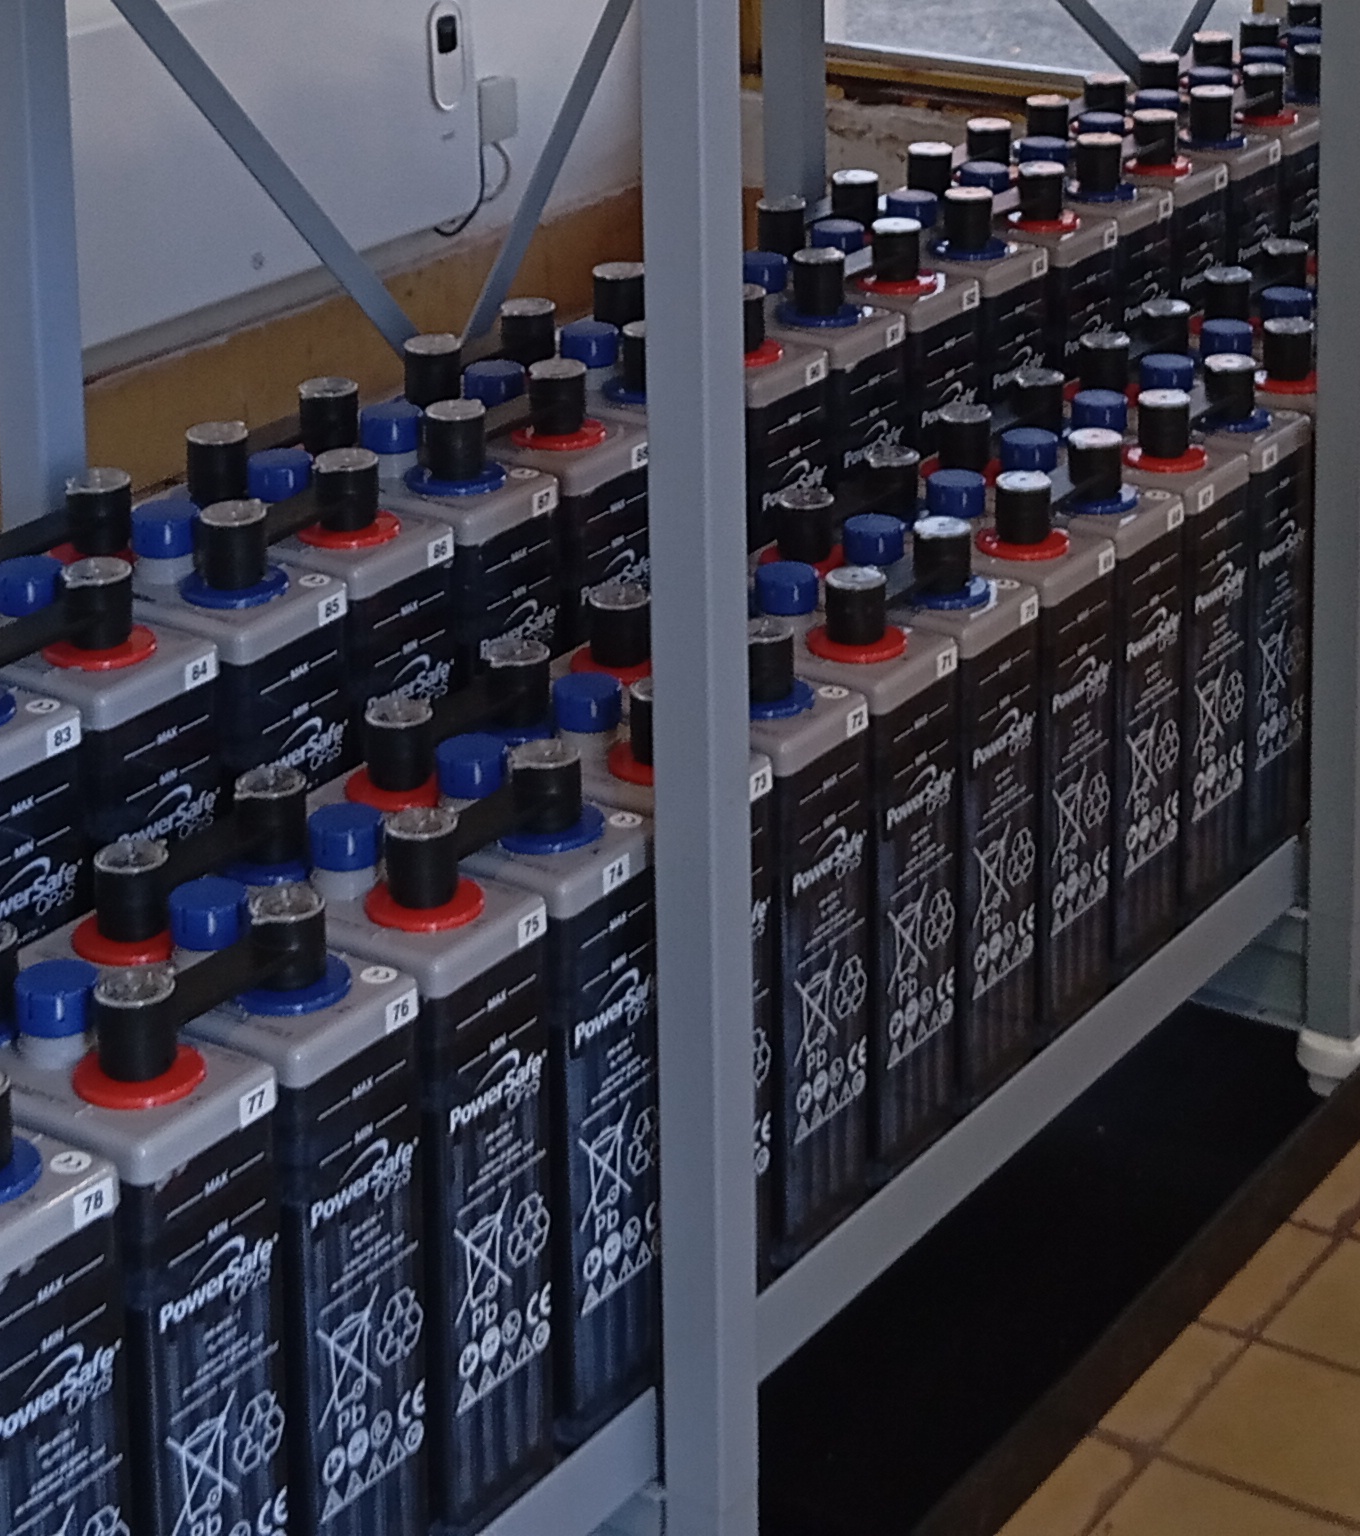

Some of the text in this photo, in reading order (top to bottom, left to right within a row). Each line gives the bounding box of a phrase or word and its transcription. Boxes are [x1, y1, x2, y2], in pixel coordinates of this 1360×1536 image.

[399, 599, 420, 617] MAX
[288, 661, 311, 682] MAX
[53, 726, 72, 747] 83
[155, 725, 179, 746] MAX
[10, 794, 35, 818] MAX
[13, 837, 35, 860] MIN
[523, 916, 540, 938] 75
[608, 910, 628, 933] MAX
[392, 999, 410, 1021] 76
[486, 987, 508, 1013] MAX
[488, 1032, 508, 1055] MIN
[246, 1089, 265, 1114] 77
[351, 1075, 375, 1101] MAX
[449, 1052, 544, 1138] PowerSafe
[353, 1121, 374, 1147] MIN
[202, 1168, 229, 1198] MAX
[310, 1141, 414, 1231] PowerSafe
[83, 1189, 104, 1216] 78
[206, 1217, 229, 1244] MIN
[594, 1207, 621, 1242] Pb
[36, 1273, 65, 1306] MAX
[159, 1236, 273, 1335] PowerSafe
[526, 1281, 552, 1328] CE
[472, 1300, 499, 1338] Pb
[40, 1324, 65, 1354] MIN
[66, 1367, 114, 1416] OPzS
[397, 1377, 427, 1427] CE
[336, 1402, 367, 1441] Pb
[258, 1484, 289, 1535] CE
